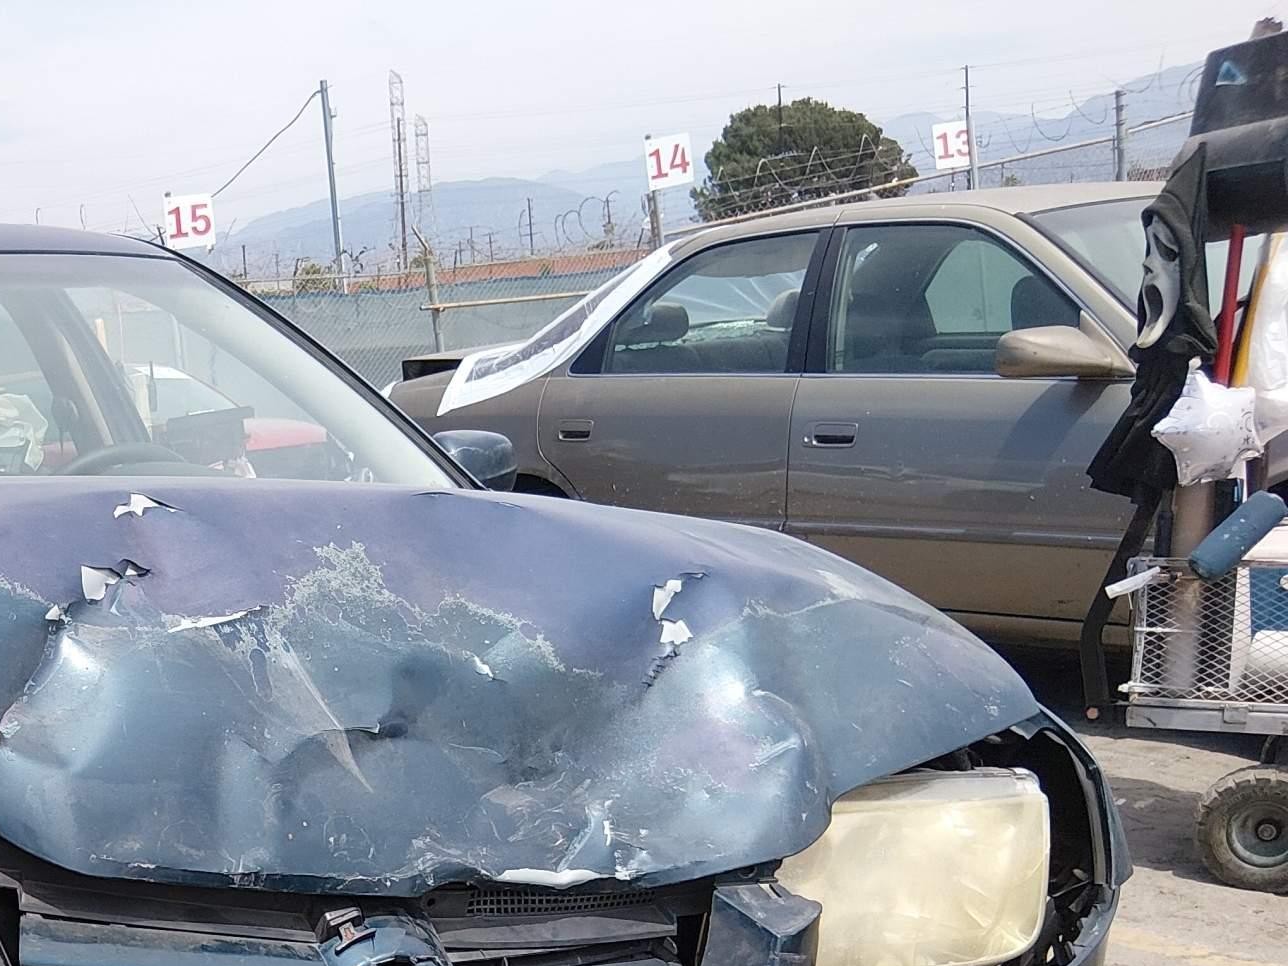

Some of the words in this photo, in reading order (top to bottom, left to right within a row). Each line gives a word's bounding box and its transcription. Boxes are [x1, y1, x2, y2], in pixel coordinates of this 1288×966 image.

[648, 143, 690, 180] 14
[936, 129, 970, 160] 13
[167, 203, 212, 240] 15
